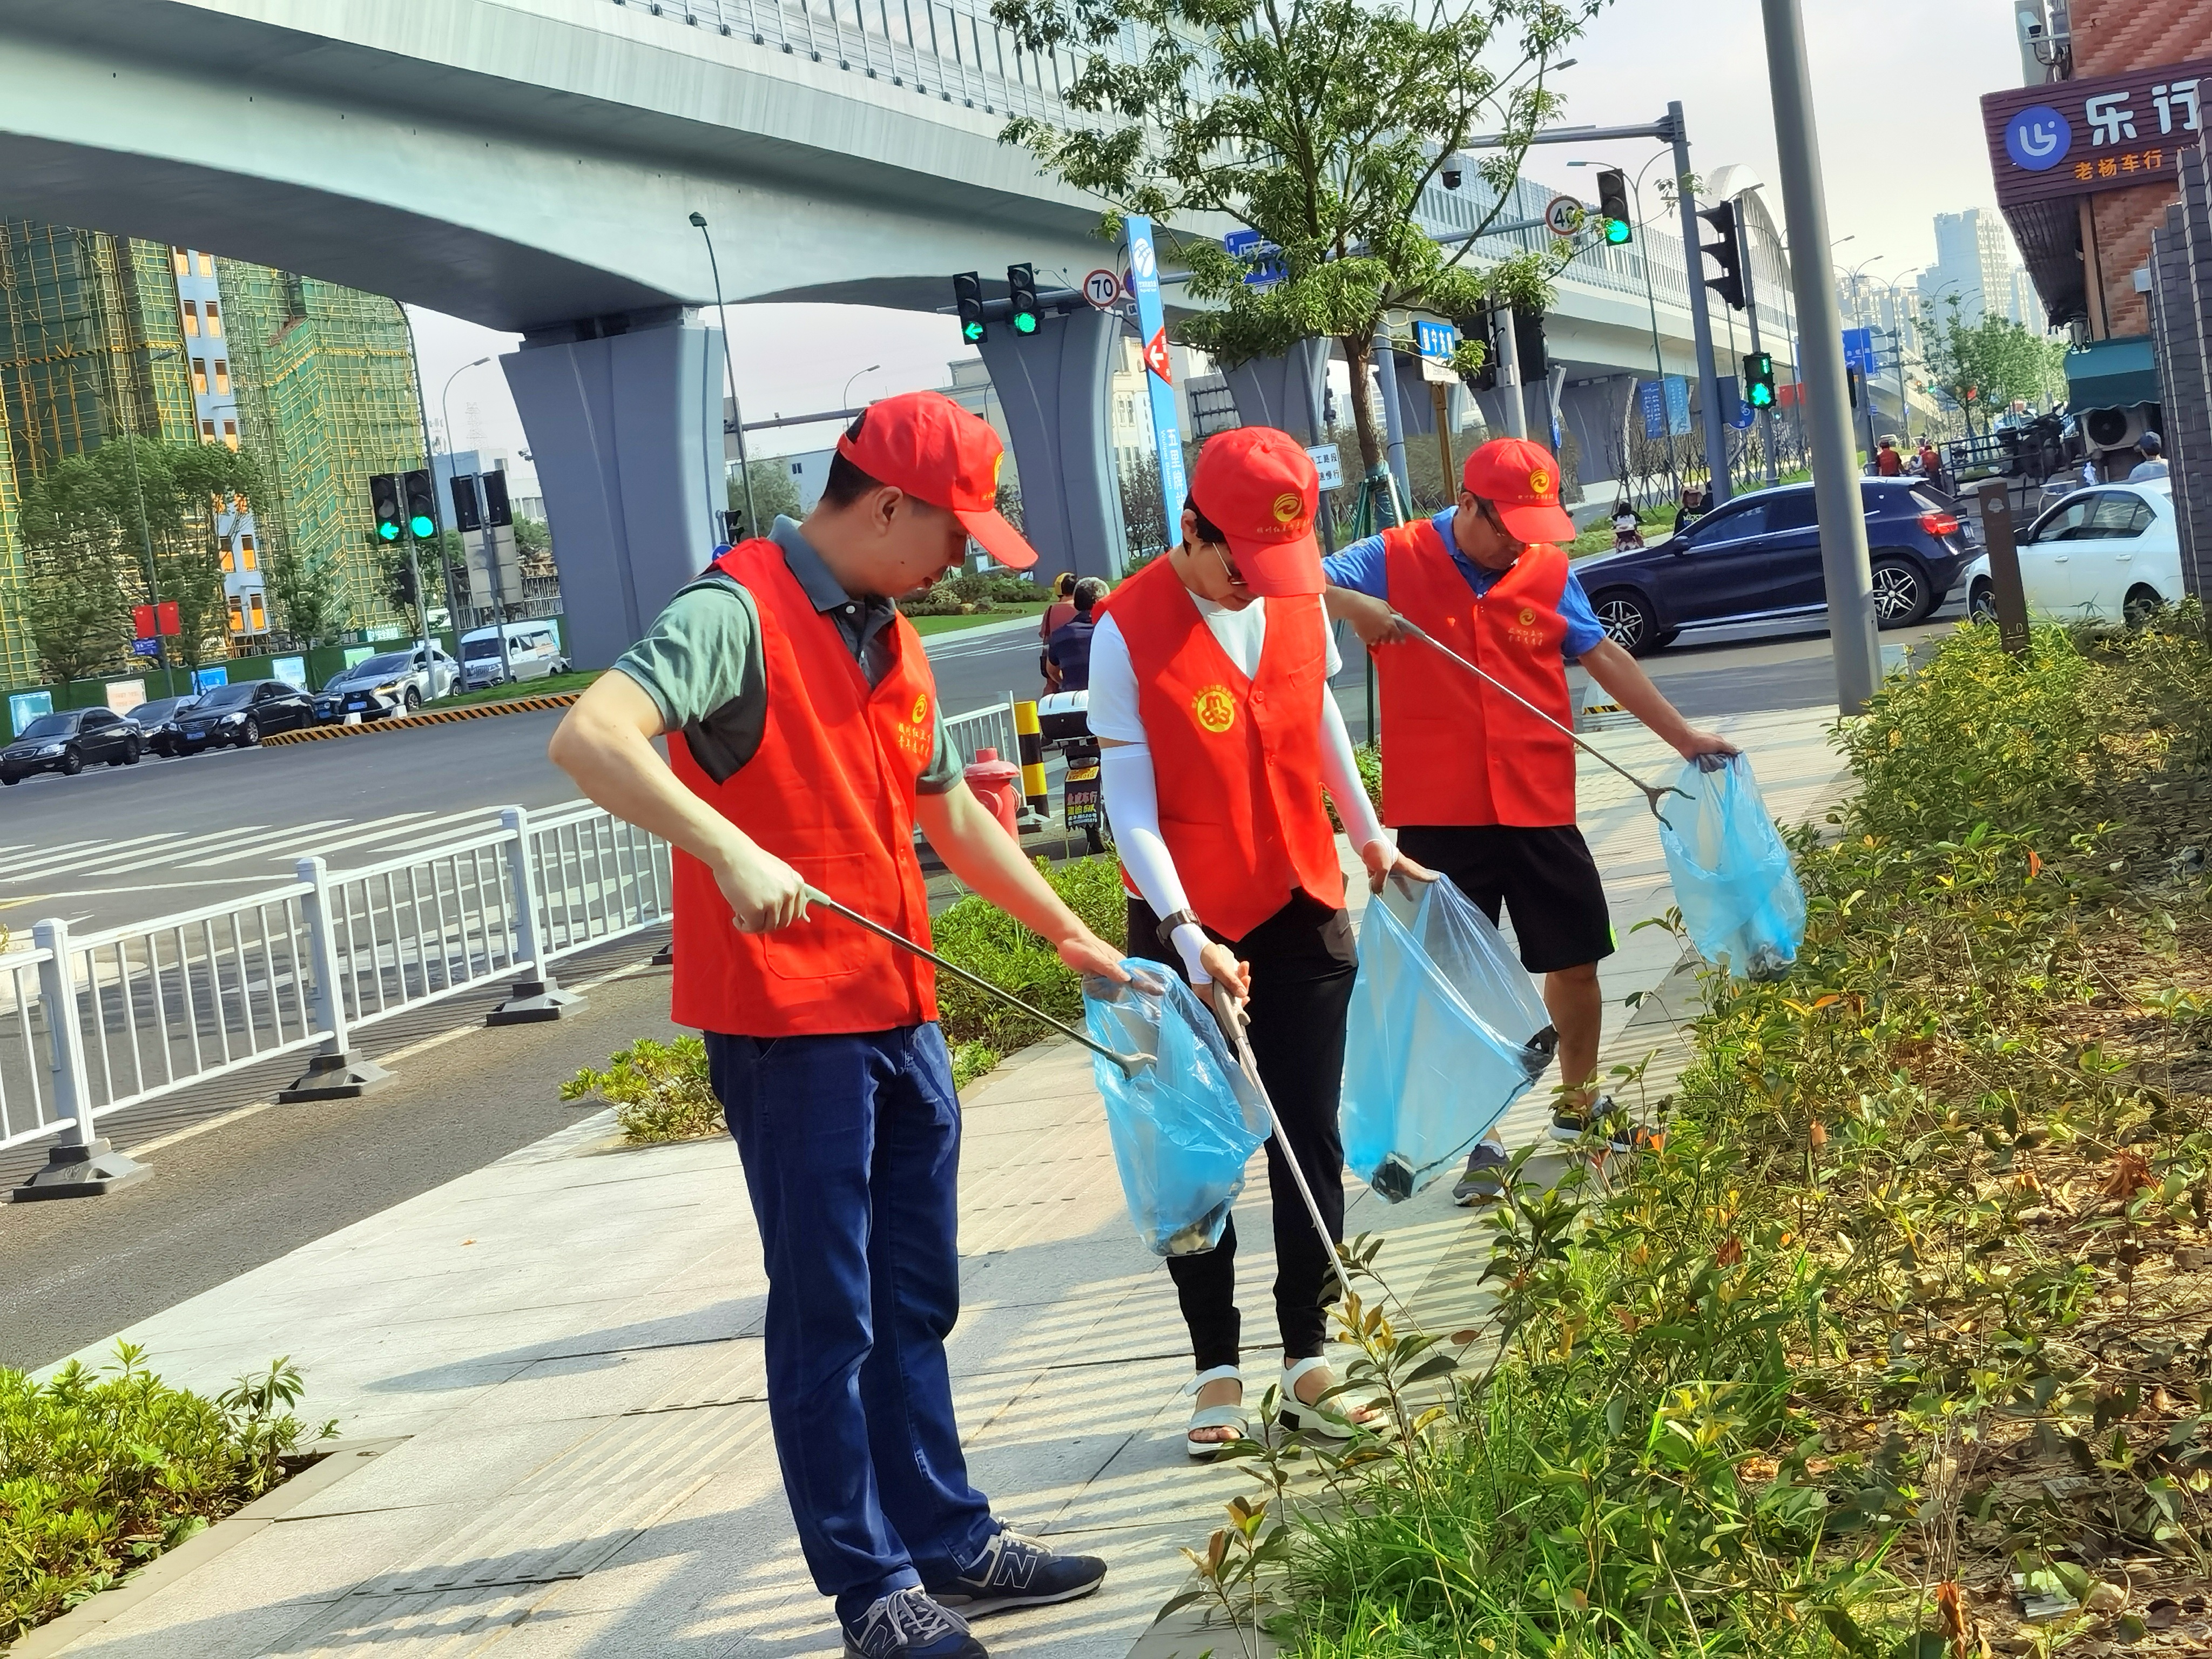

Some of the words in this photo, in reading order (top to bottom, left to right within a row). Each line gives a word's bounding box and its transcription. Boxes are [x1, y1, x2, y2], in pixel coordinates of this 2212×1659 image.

[2074, 149, 2162, 180] 老杨车行
[1091, 278, 1113, 299] 70
[1161, 430, 1169, 460] Wulipai
[1311, 453, 1338, 464] 工路段
[1166, 428, 1185, 511] 五里牌站
[993, 1551, 1037, 1589] N
